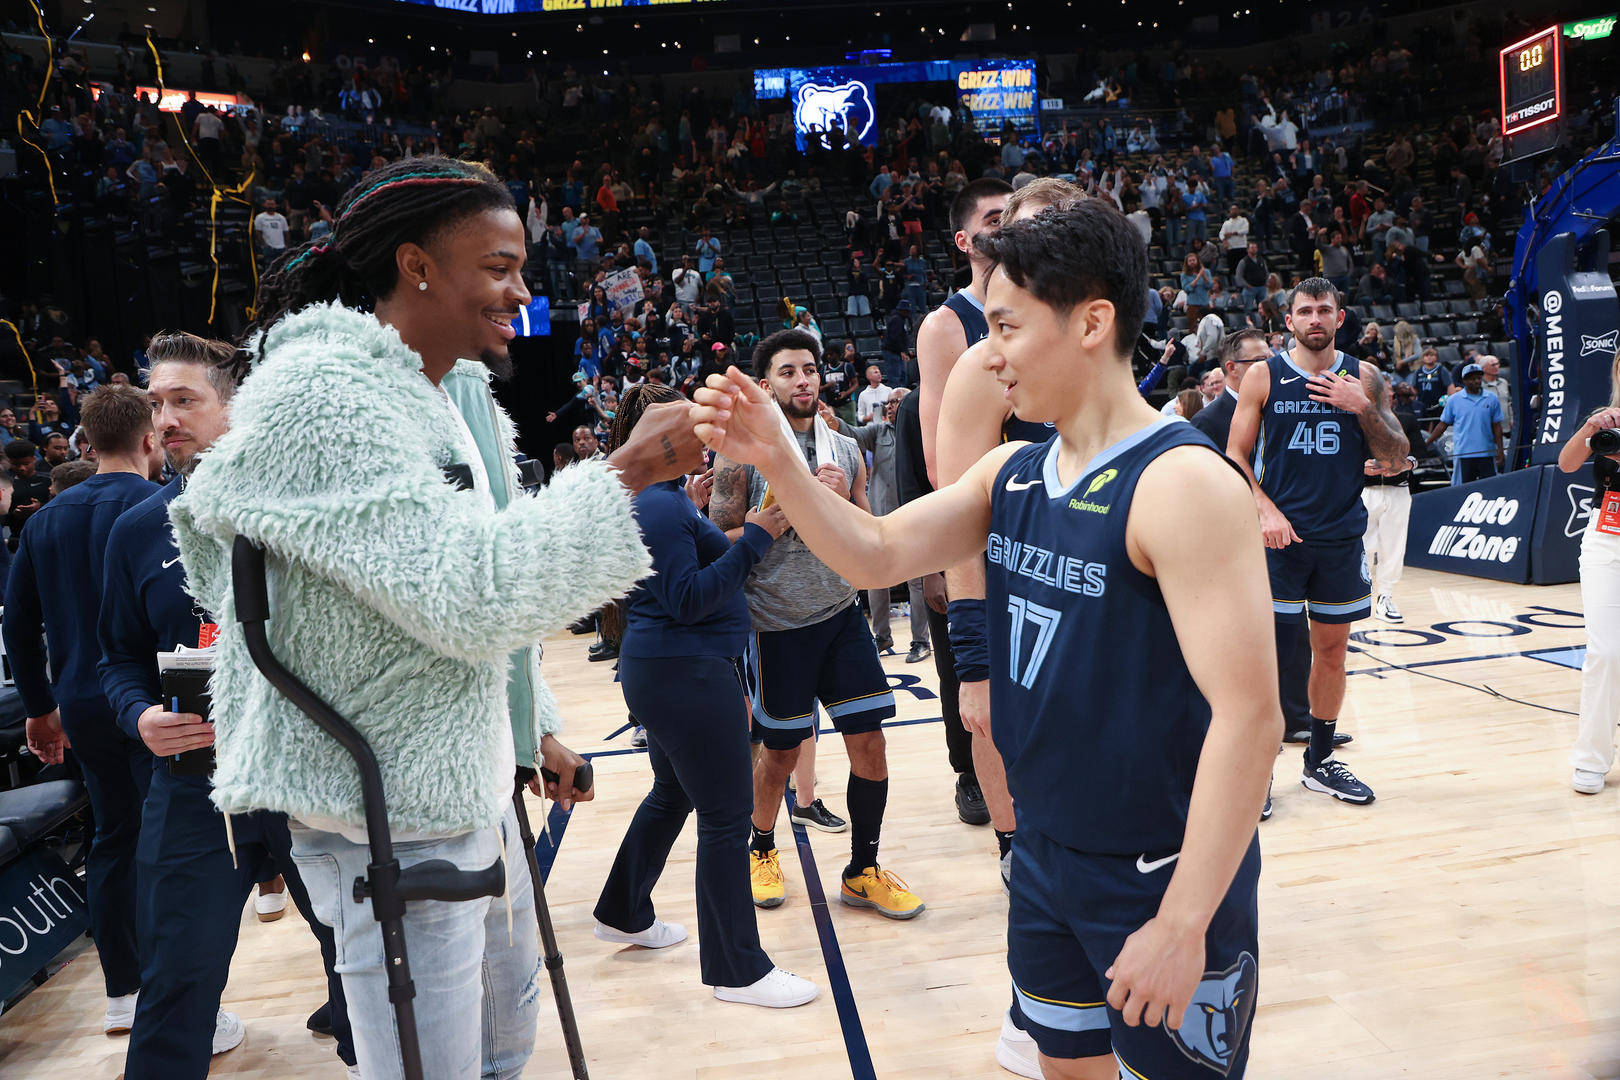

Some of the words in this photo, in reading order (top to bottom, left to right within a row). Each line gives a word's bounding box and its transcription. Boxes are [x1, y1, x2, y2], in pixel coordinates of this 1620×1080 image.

[958, 71, 999, 90] GRIZZ
[1001, 69, 1031, 87] WIN
[962, 94, 1000, 111] GRIZZ
[1004, 92, 1033, 109] WIN
[1518, 98, 1555, 120] TISSOT
[1585, 338, 1614, 350] SONIC
[1541, 290, 1565, 445] @MEMGRIZZ
[1274, 400, 1357, 415] GRIZZL
[1287, 421, 1341, 455] 46
[1069, 498, 1111, 515] Robinhood
[1453, 491, 1519, 526] Auto
[1449, 526, 1519, 564] Zone
[987, 532, 1107, 598] GRIZZLIES
[1007, 593, 1063, 690] 17
[0, 874, 85, 955] outh
